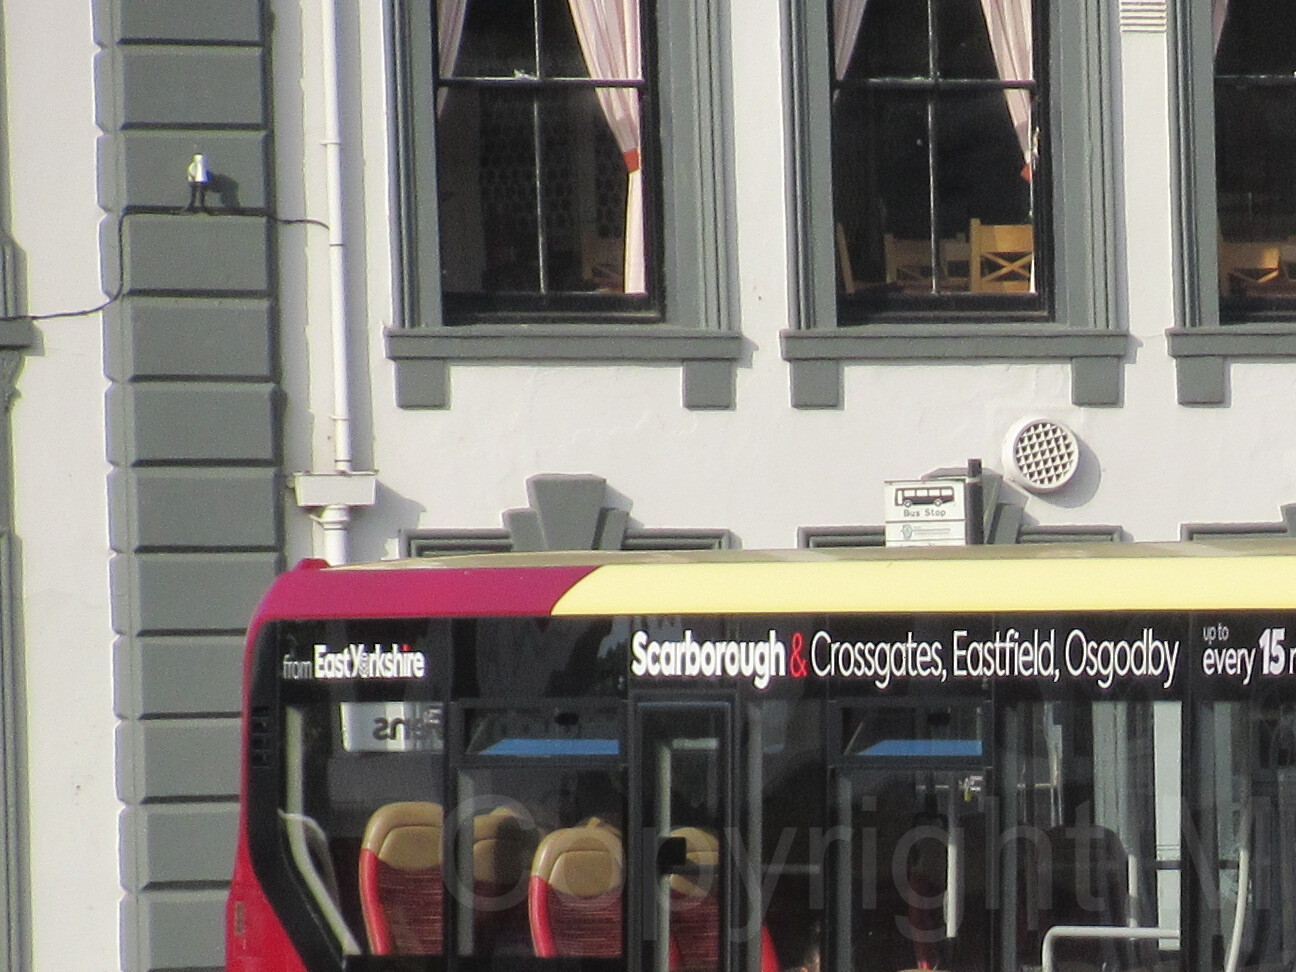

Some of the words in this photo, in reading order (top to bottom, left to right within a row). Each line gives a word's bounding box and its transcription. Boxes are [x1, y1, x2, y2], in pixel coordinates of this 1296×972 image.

[903, 509, 920, 517] Bus
[924, 508, 946, 517] Stop
[1203, 626, 1216, 645] up
[1217, 622, 1229, 640] to
[283, 654, 313, 679] from
[631, 629, 786, 689] Scarborough
[789, 632, 807, 678] &
[811, 630, 947, 689] Crossgates,
[953, 628, 1060, 682] Eastfield,
[1065, 628, 1180, 689] Osgodby
[1203, 647, 1256, 685] every
[1258, 627, 1286, 675] 15
